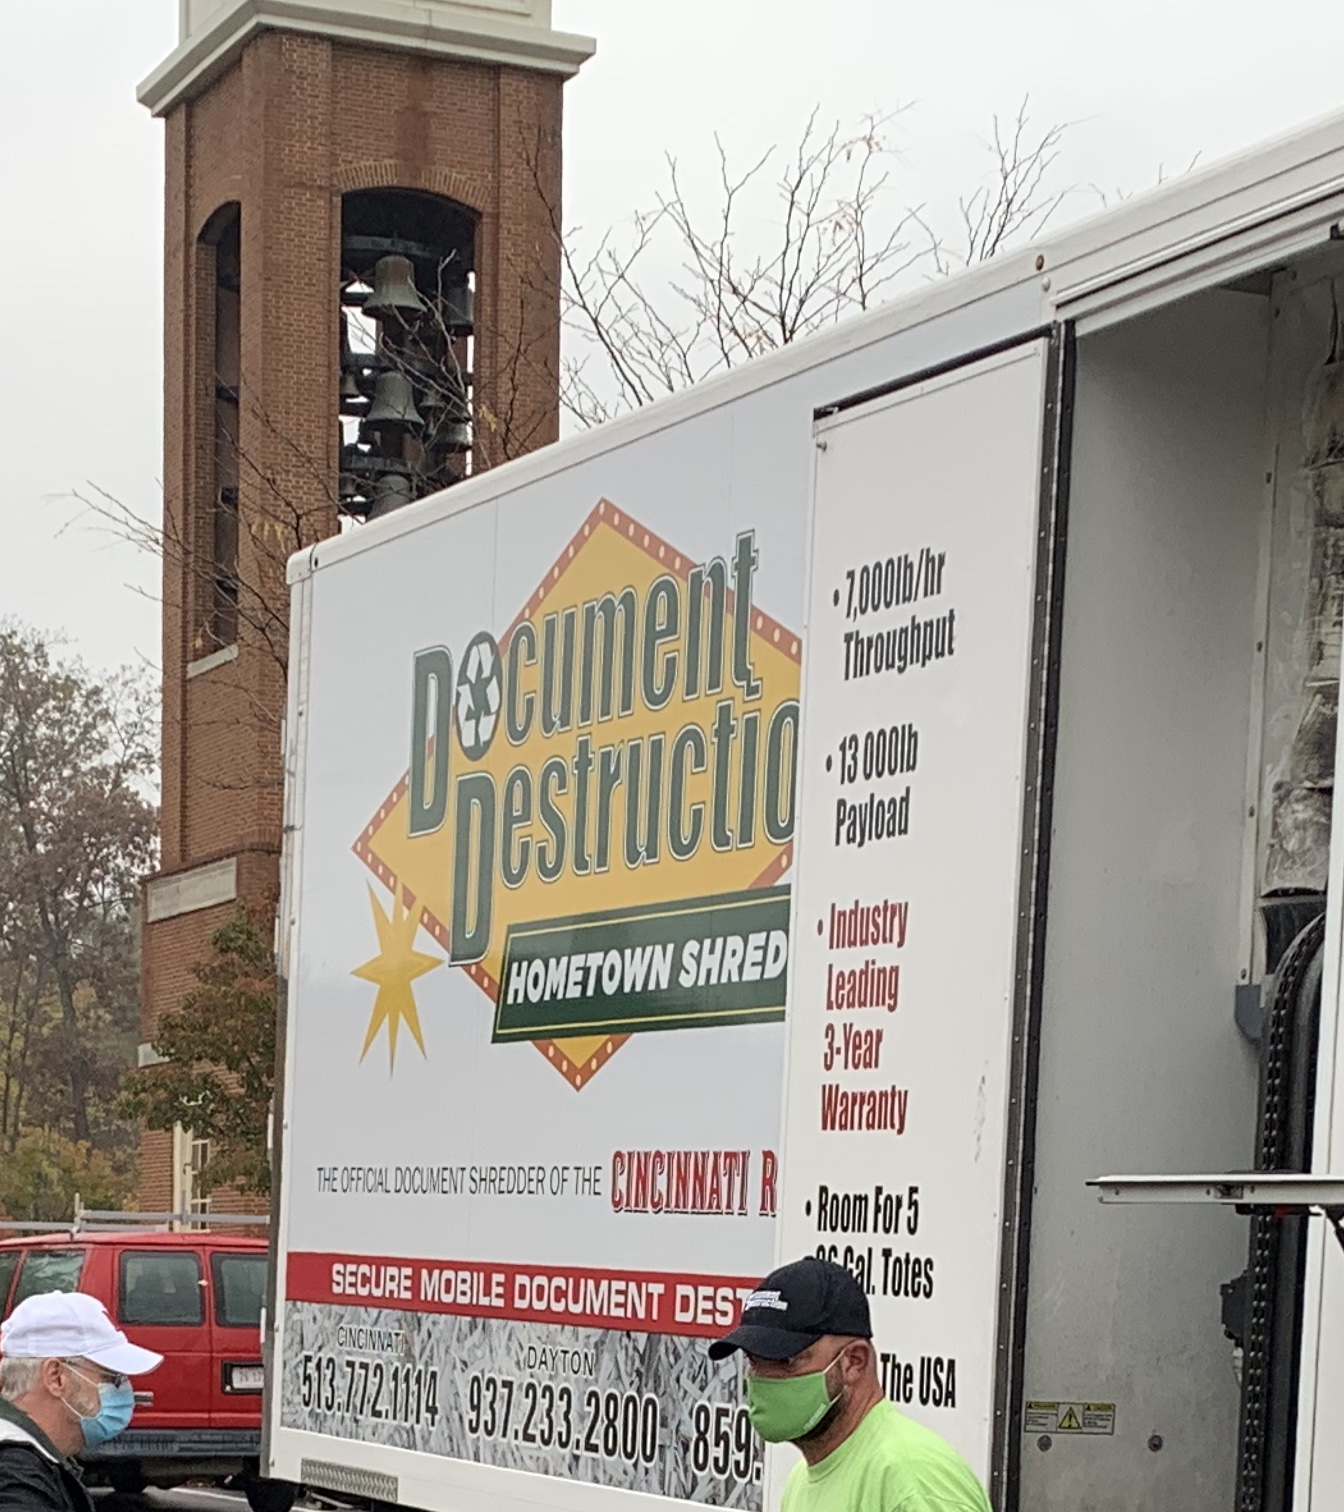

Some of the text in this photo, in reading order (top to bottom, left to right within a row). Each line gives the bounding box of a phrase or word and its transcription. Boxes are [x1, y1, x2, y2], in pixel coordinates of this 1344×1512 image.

[845, 547, 947, 622] 7,000lb/hr
[843, 608, 956, 681] Throughput
[834, 786, 911, 848] Payload
[828, 901, 909, 949] Industry
[506, 929, 788, 1006] HOMETOWN SHRED
[825, 959, 900, 1012] Leading
[823, 1021, 884, 1072] 3-Year
[820, 1083, 909, 1135] Warranty
[317, 1166, 338, 1193] THE
[340, 1166, 391, 1194] OFFICIAL
[394, 1166, 466, 1195] DOCUMENT
[468, 1166, 546, 1196] SHREDDER
[549, 1165, 569, 1196] OF
[573, 1165, 603, 1196] THE
[610, 1148, 752, 1217] CINCINNATI
[816, 1185, 920, 1236] Room For 5
[331, 1262, 413, 1300] SECURE
[420, 1267, 506, 1308] MOBILE
[512, 1274, 665, 1321] DOCUMENT
[881, 1247, 935, 1299] Totes
[336, 1325, 404, 1354] CINCINNATI
[527, 1345, 596, 1378] DAYTON
[879, 1353, 957, 1409] The USA
[301, 1353, 440, 1429] 513.772.1114
[467, 1373, 660, 1465] 937.233.2800
